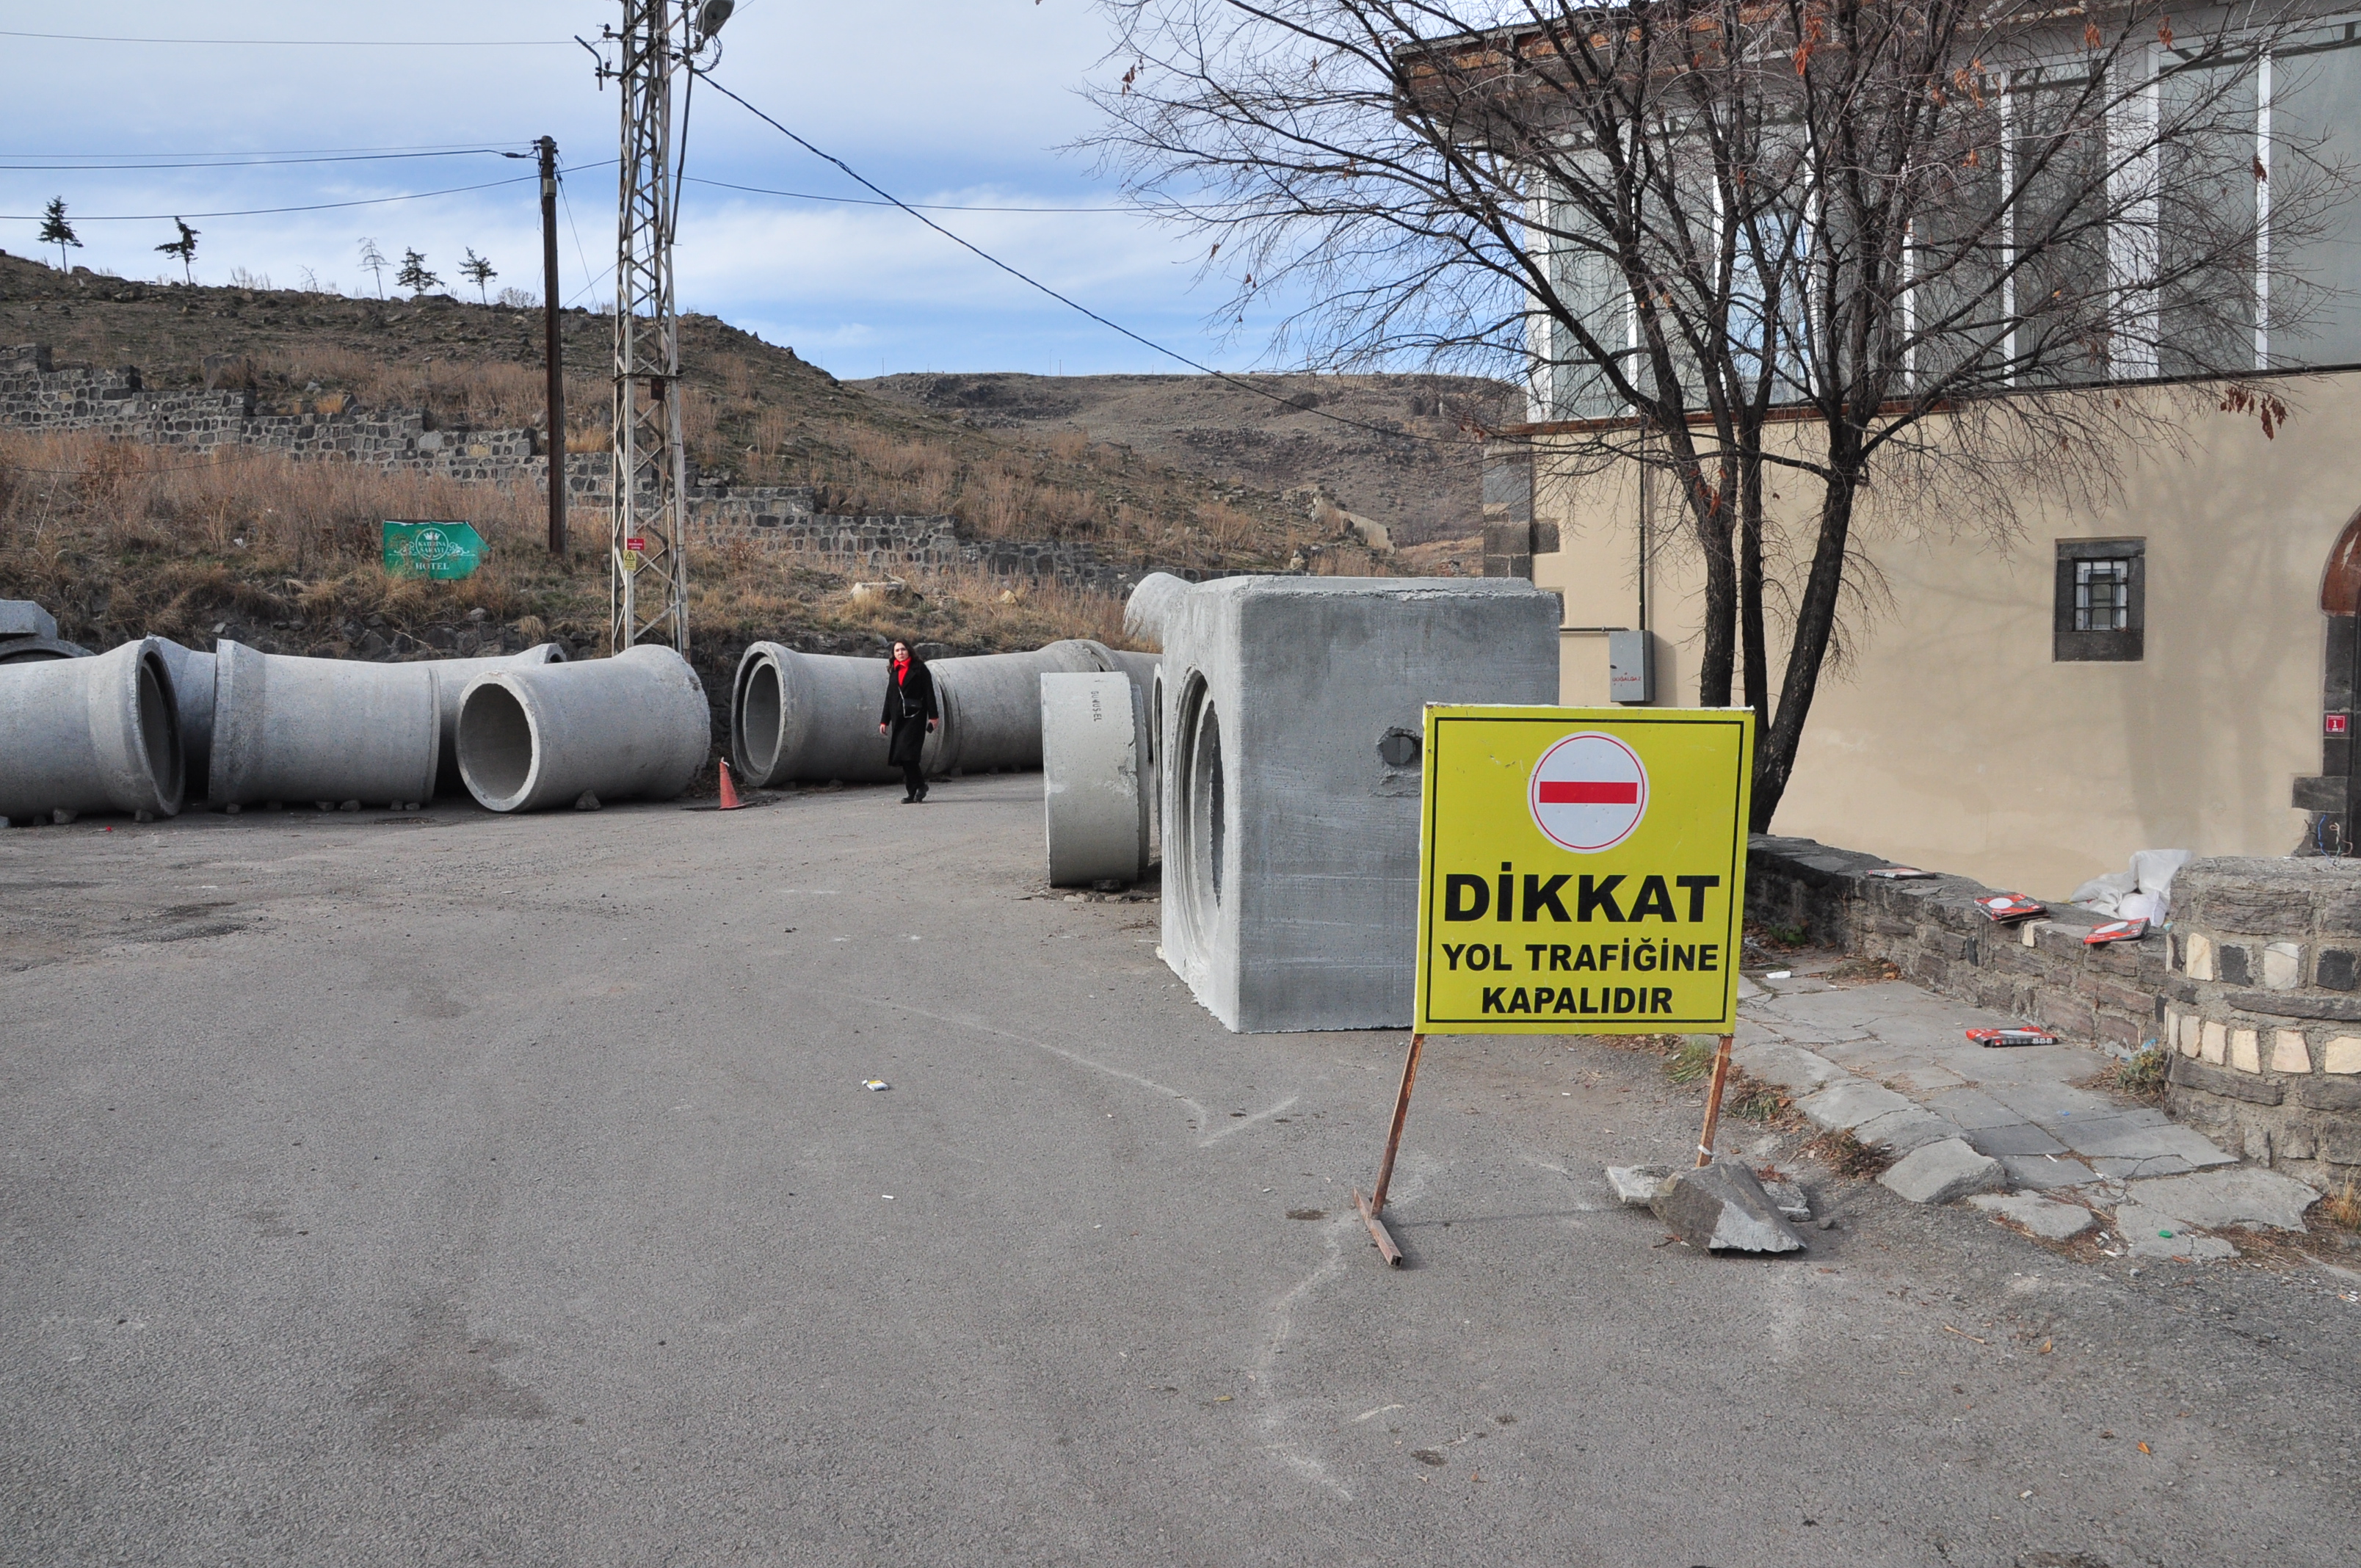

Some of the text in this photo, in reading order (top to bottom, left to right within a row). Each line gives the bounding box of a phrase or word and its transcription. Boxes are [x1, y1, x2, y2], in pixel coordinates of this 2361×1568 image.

[1444, 861, 1720, 923] DİKKAT
[1442, 937, 1719, 972] YOL TRAFİĞİNE
[1481, 987, 1673, 1014] KAPALIDIR
